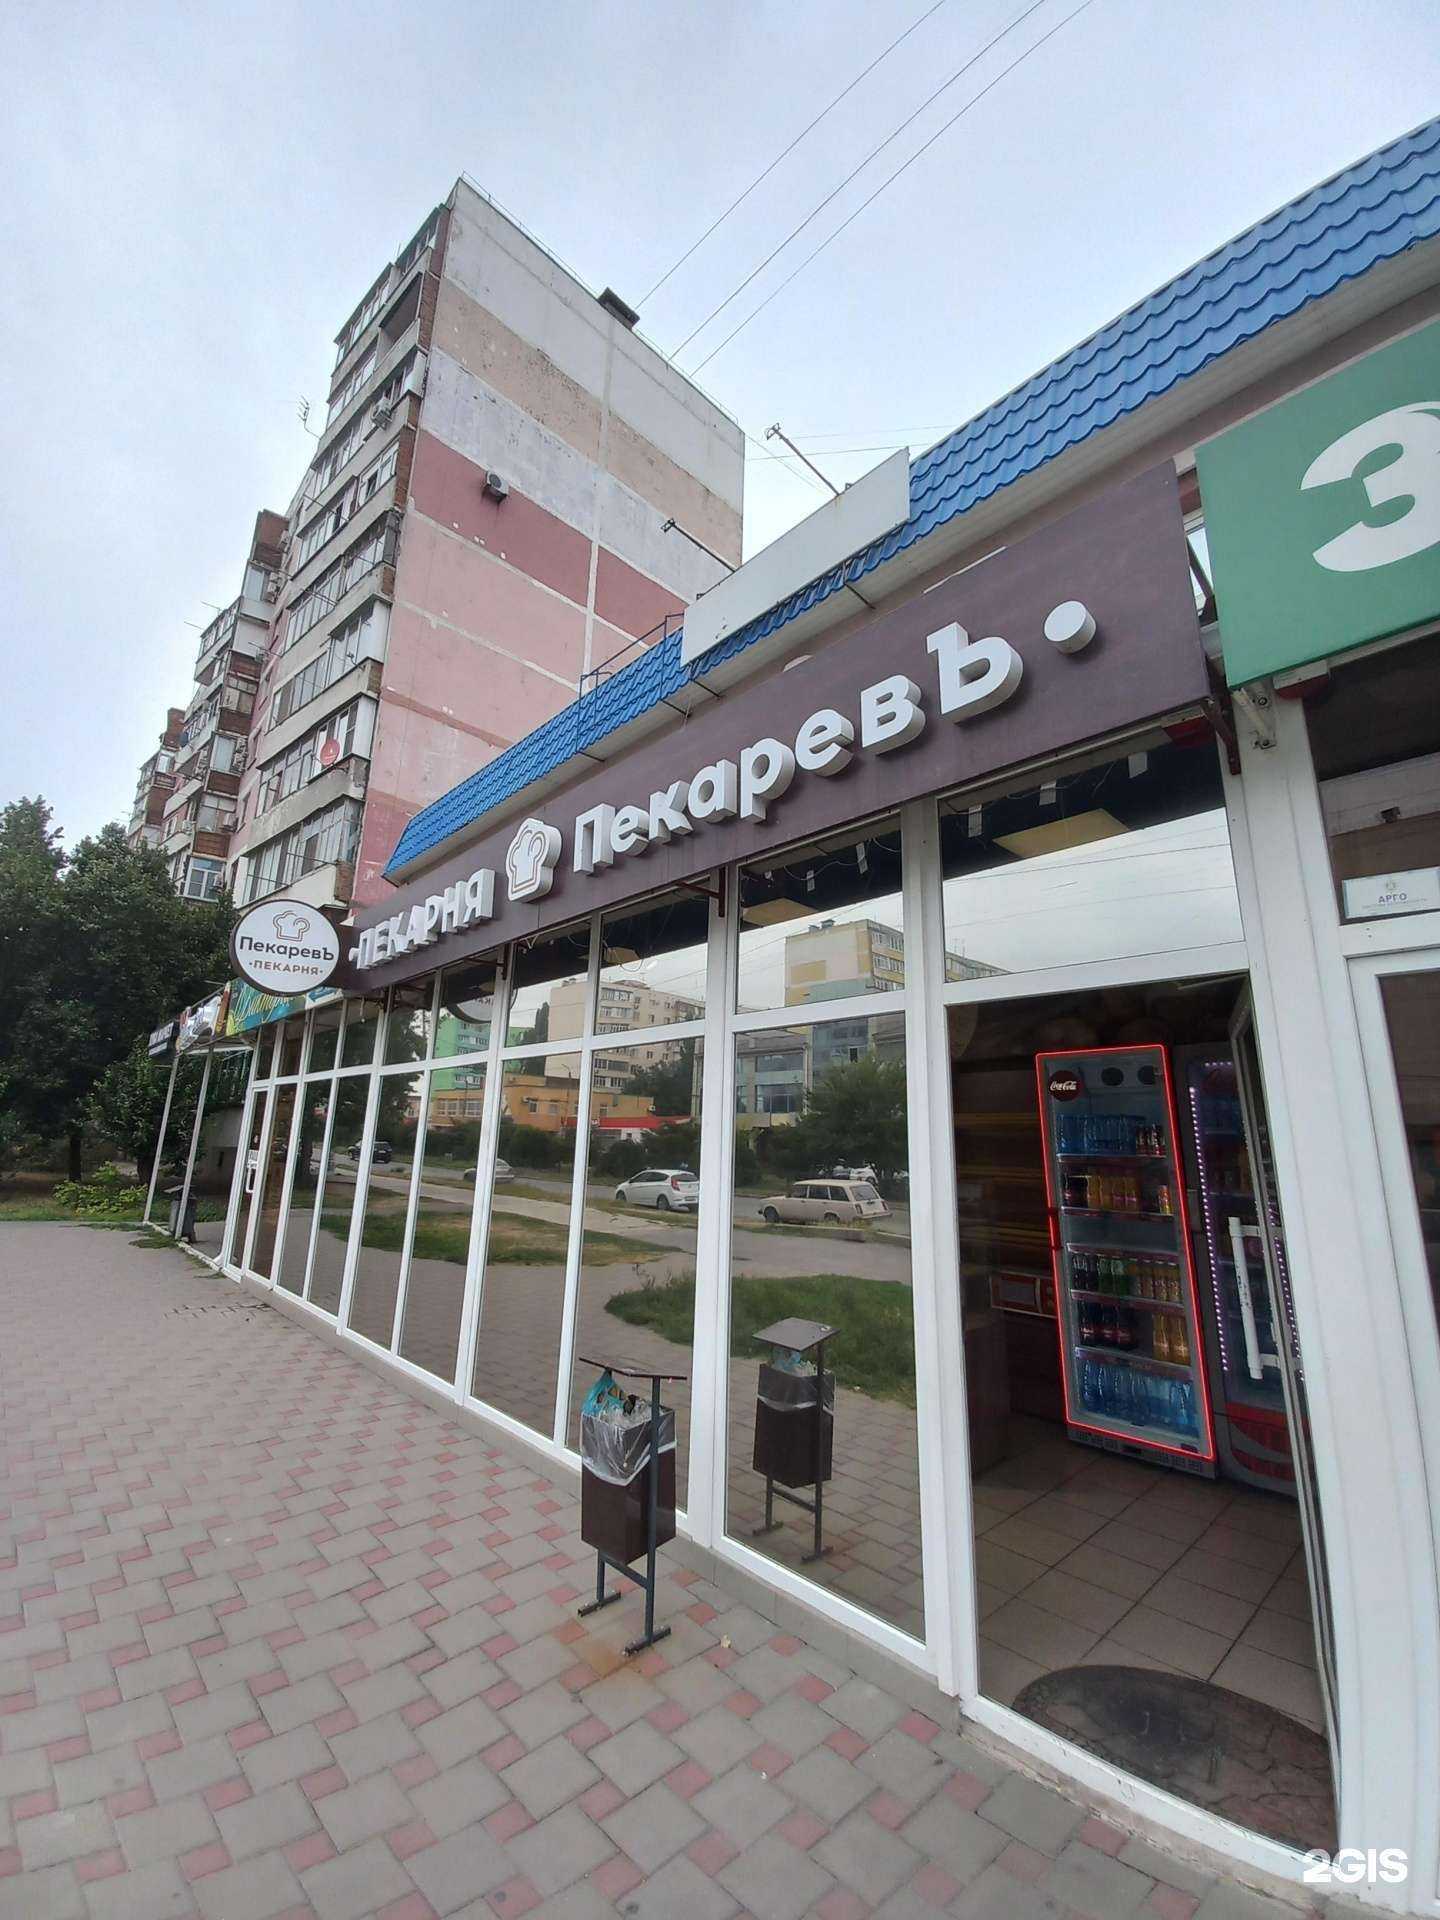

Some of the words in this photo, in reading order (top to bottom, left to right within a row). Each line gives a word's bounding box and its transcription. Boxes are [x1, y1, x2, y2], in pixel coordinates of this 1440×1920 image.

[356, 868, 496, 970] ПЕКАРНЯ
[573, 621, 1023, 875] ПекаревЪ
[240, 936, 335, 961] ПекаревЪ
